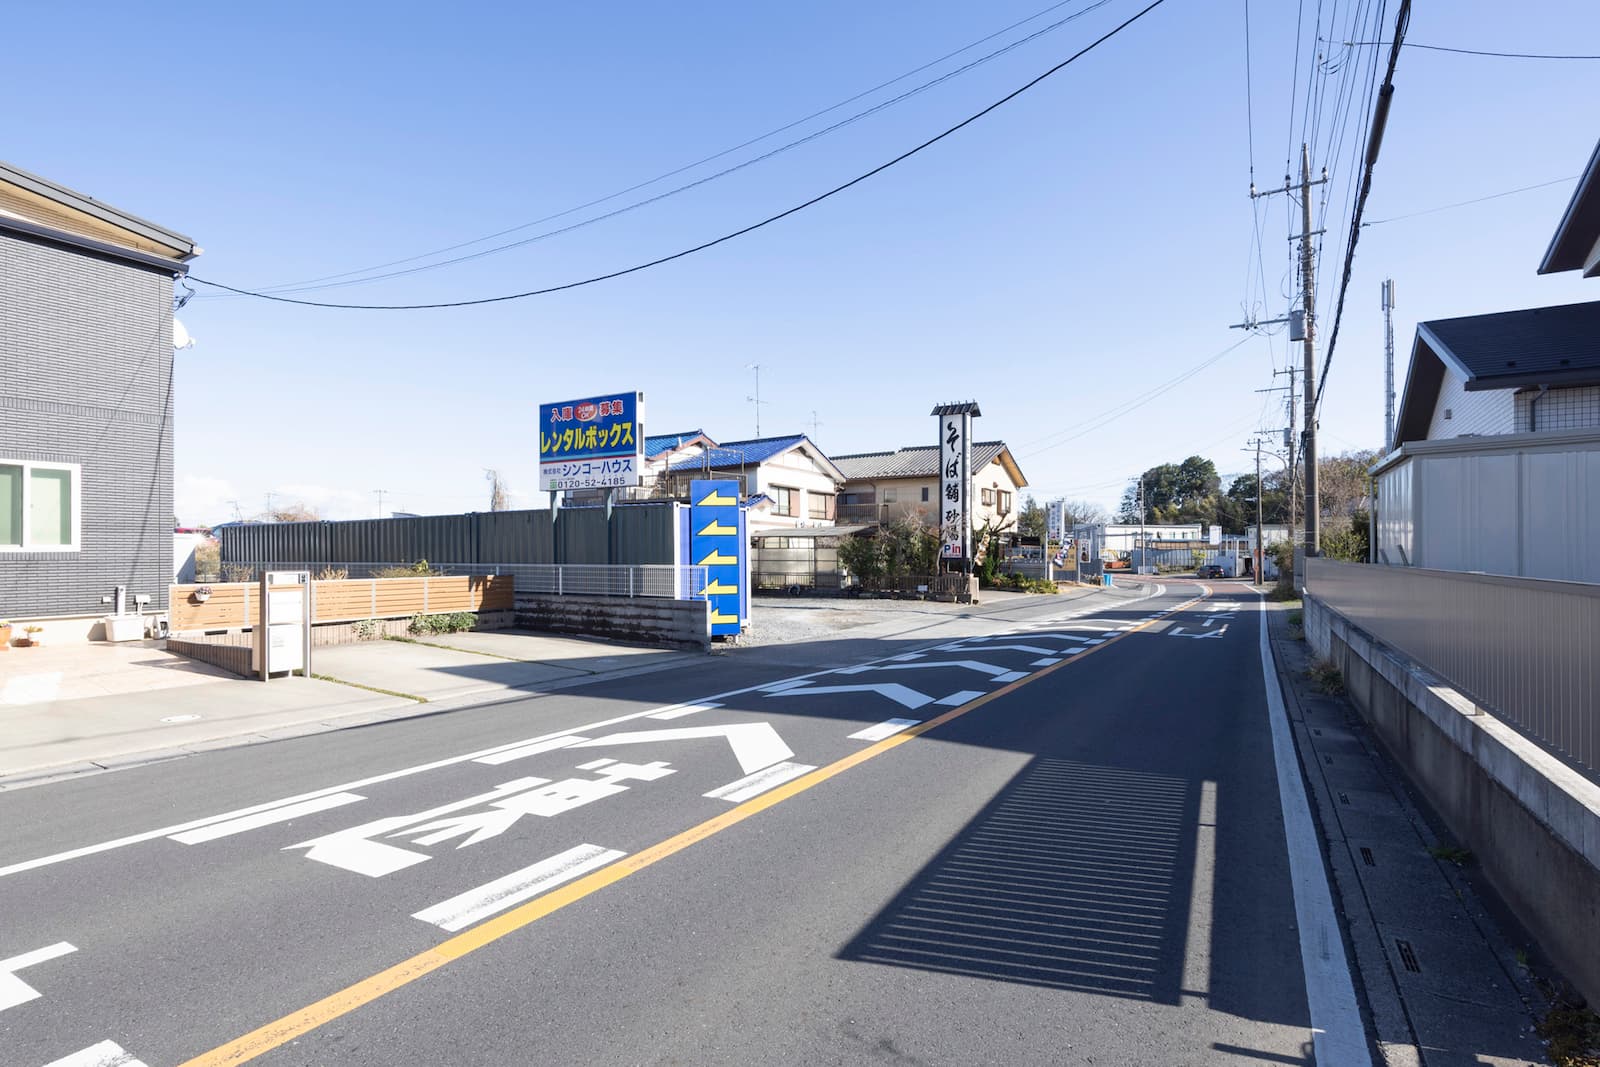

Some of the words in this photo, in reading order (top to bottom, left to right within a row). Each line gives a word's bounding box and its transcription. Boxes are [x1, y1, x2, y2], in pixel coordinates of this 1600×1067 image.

[551, 407, 573, 423] 入庫
[599, 399, 624, 416] 募集
[541, 422, 634, 453] レンタルボックス
[563, 459, 632, 477] シンコーハウス
[557, 477, 626, 489] 0120-52-4185
